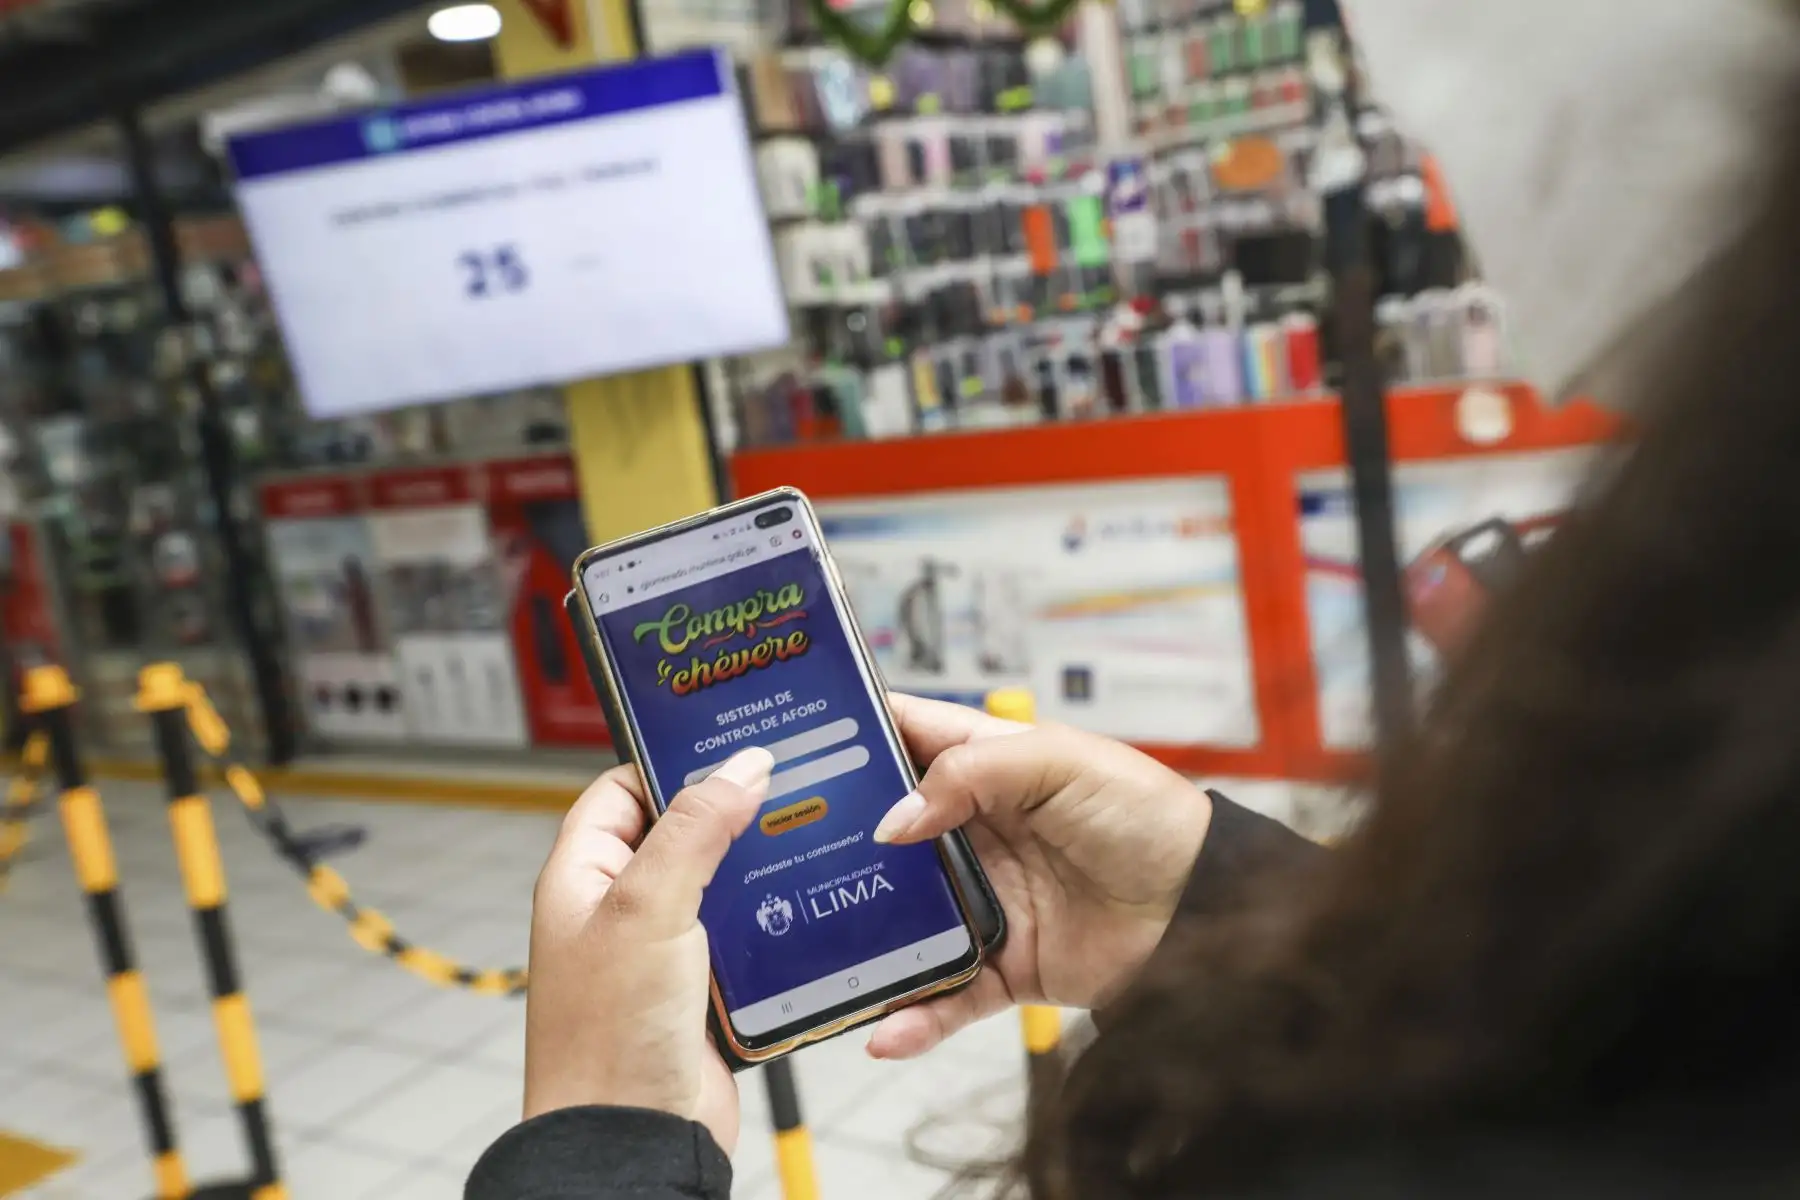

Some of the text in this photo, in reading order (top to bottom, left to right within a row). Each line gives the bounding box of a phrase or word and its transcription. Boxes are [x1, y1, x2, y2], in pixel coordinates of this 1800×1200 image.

[633, 582, 803, 655] Compra
[671, 630, 809, 697] chévere
[694, 699, 827, 753] CONTROL DE AFORO
[715, 690, 793, 726] SISTEMA DE
[794, 853, 805, 863] tu
[806, 830, 864, 860] contraseña?
[807, 861, 885, 895] MUNICIPALIDAD DE
[811, 874, 894, 919] LIMA
